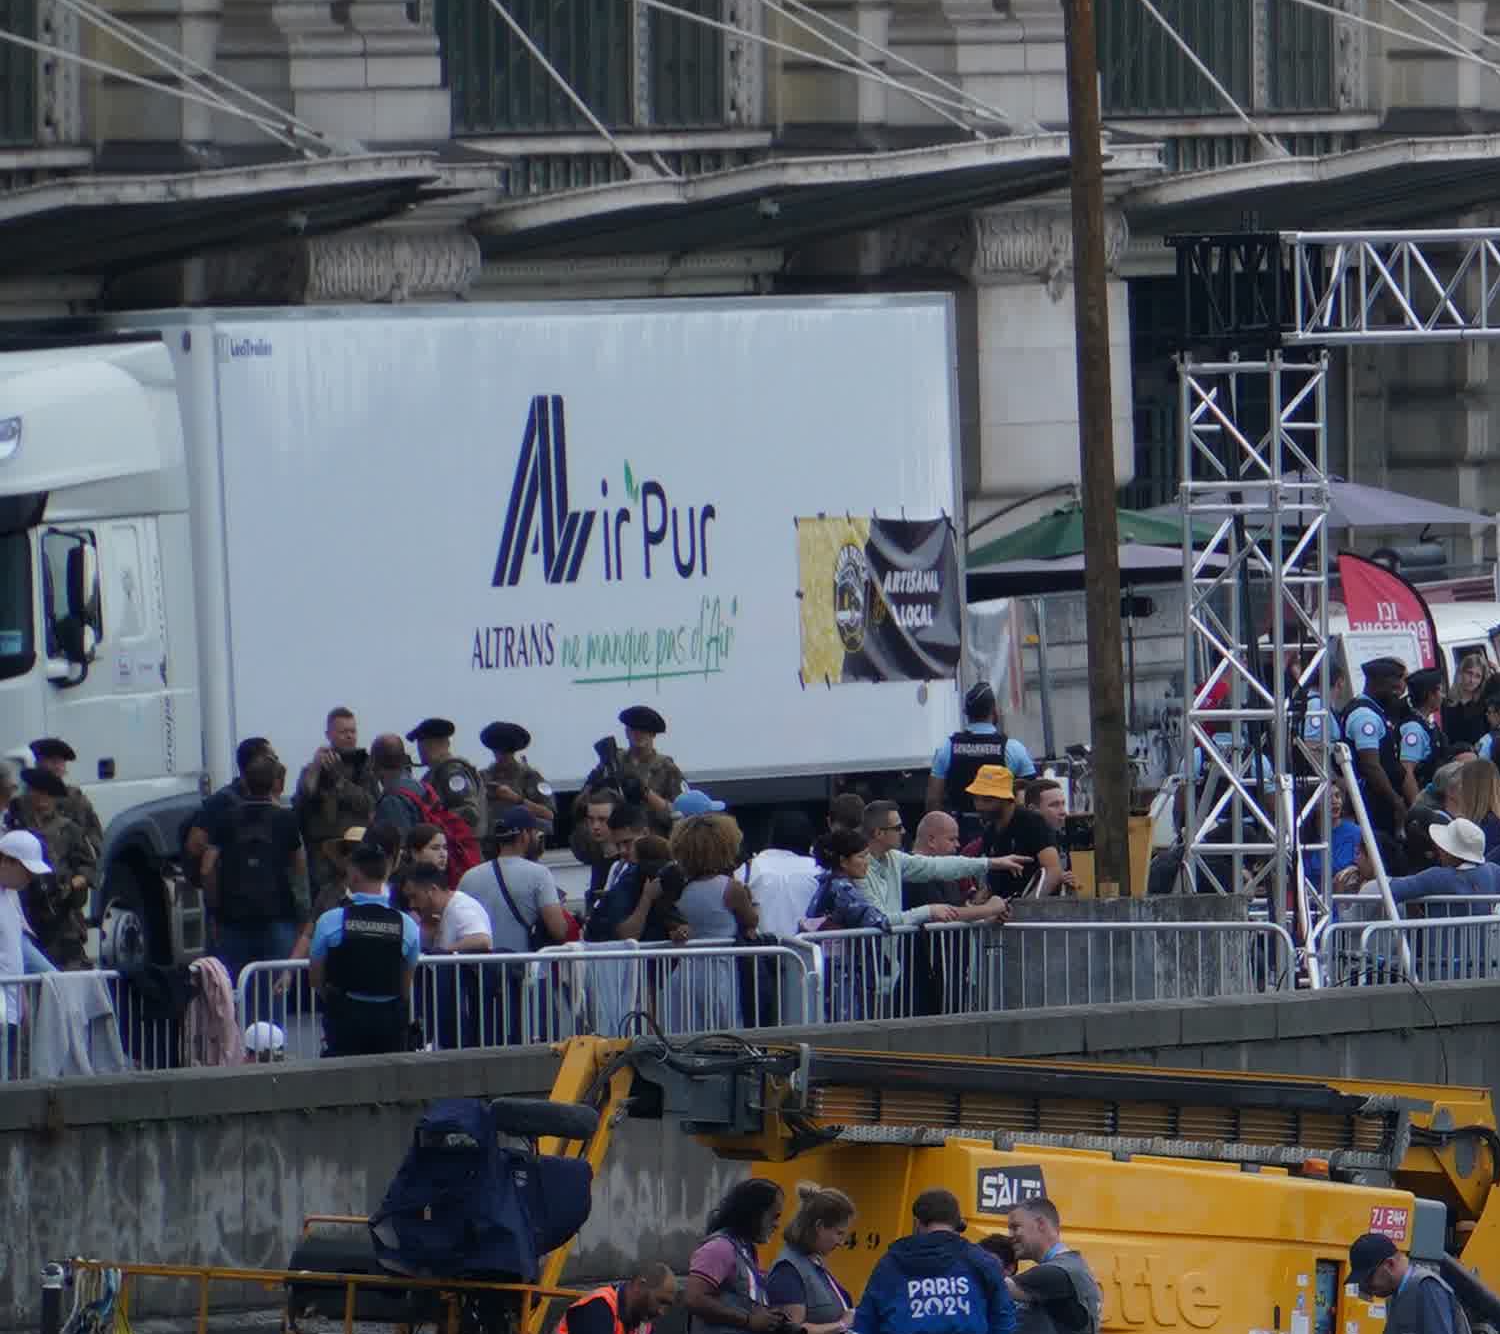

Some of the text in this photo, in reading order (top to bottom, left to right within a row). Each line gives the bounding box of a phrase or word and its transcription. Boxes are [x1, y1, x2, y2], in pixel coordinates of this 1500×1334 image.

[641, 480, 717, 580] Pur
[472, 622, 555, 671] ALTRANS
[562, 633, 580, 669] ne
[587, 626, 650, 687] manque
[656, 625, 686, 695] pas
[910, 1297, 971, 1318] 2024
